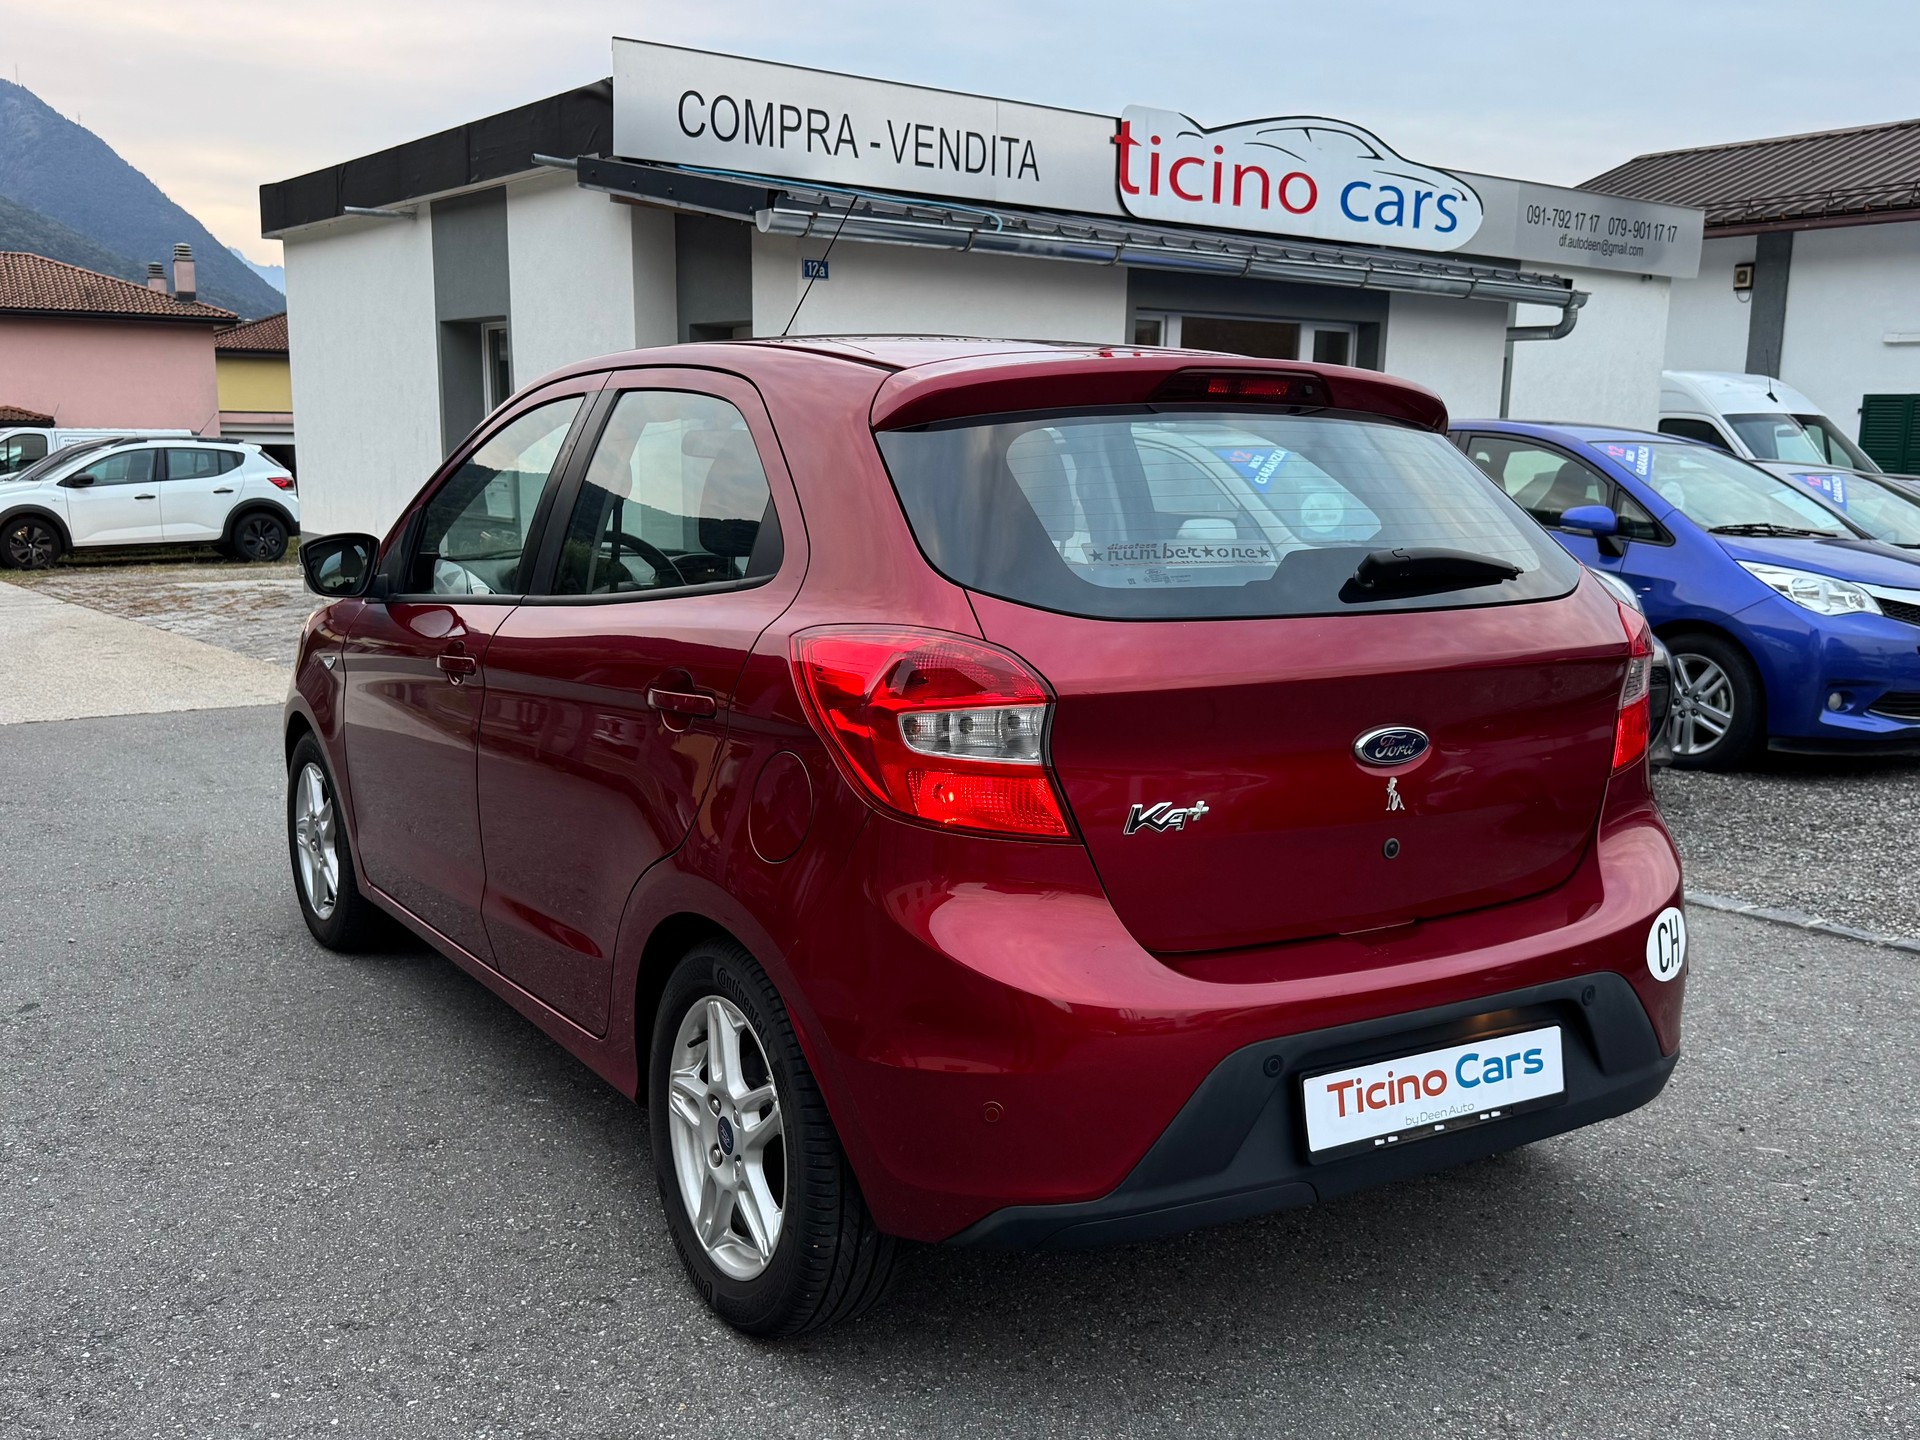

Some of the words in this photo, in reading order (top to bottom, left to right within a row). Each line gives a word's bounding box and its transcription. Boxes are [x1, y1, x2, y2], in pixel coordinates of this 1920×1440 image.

[678, 90, 859, 159] COMPRA
[1114, 121, 1318, 215] ticino
[1339, 180, 1459, 234] cars
[1526, 204, 1572, 229] 091-792
[1574, 212, 1586, 231] 17
[1588, 214, 1600, 233] 17
[1608, 216, 1652, 240] 079-901
[1654, 223, 1665, 242] 17
[1667, 225, 1678, 243] 17
[1558, 233, 1644, 257] df.autodeen@gmail.com
[807, 261, 826, 277] 12a
[1254, 449, 1288, 485] GARANZIA
[1375, 734, 1417, 758] Ford
[1657, 914, 1680, 973] CH
[1326, 1069, 1448, 1118] Ticino
[1455, 1048, 1545, 1089] Cars
[1405, 1115, 1419, 1126] by
[1420, 1109, 1448, 1122] Deen
[1448, 1103, 1475, 1116] Auto
